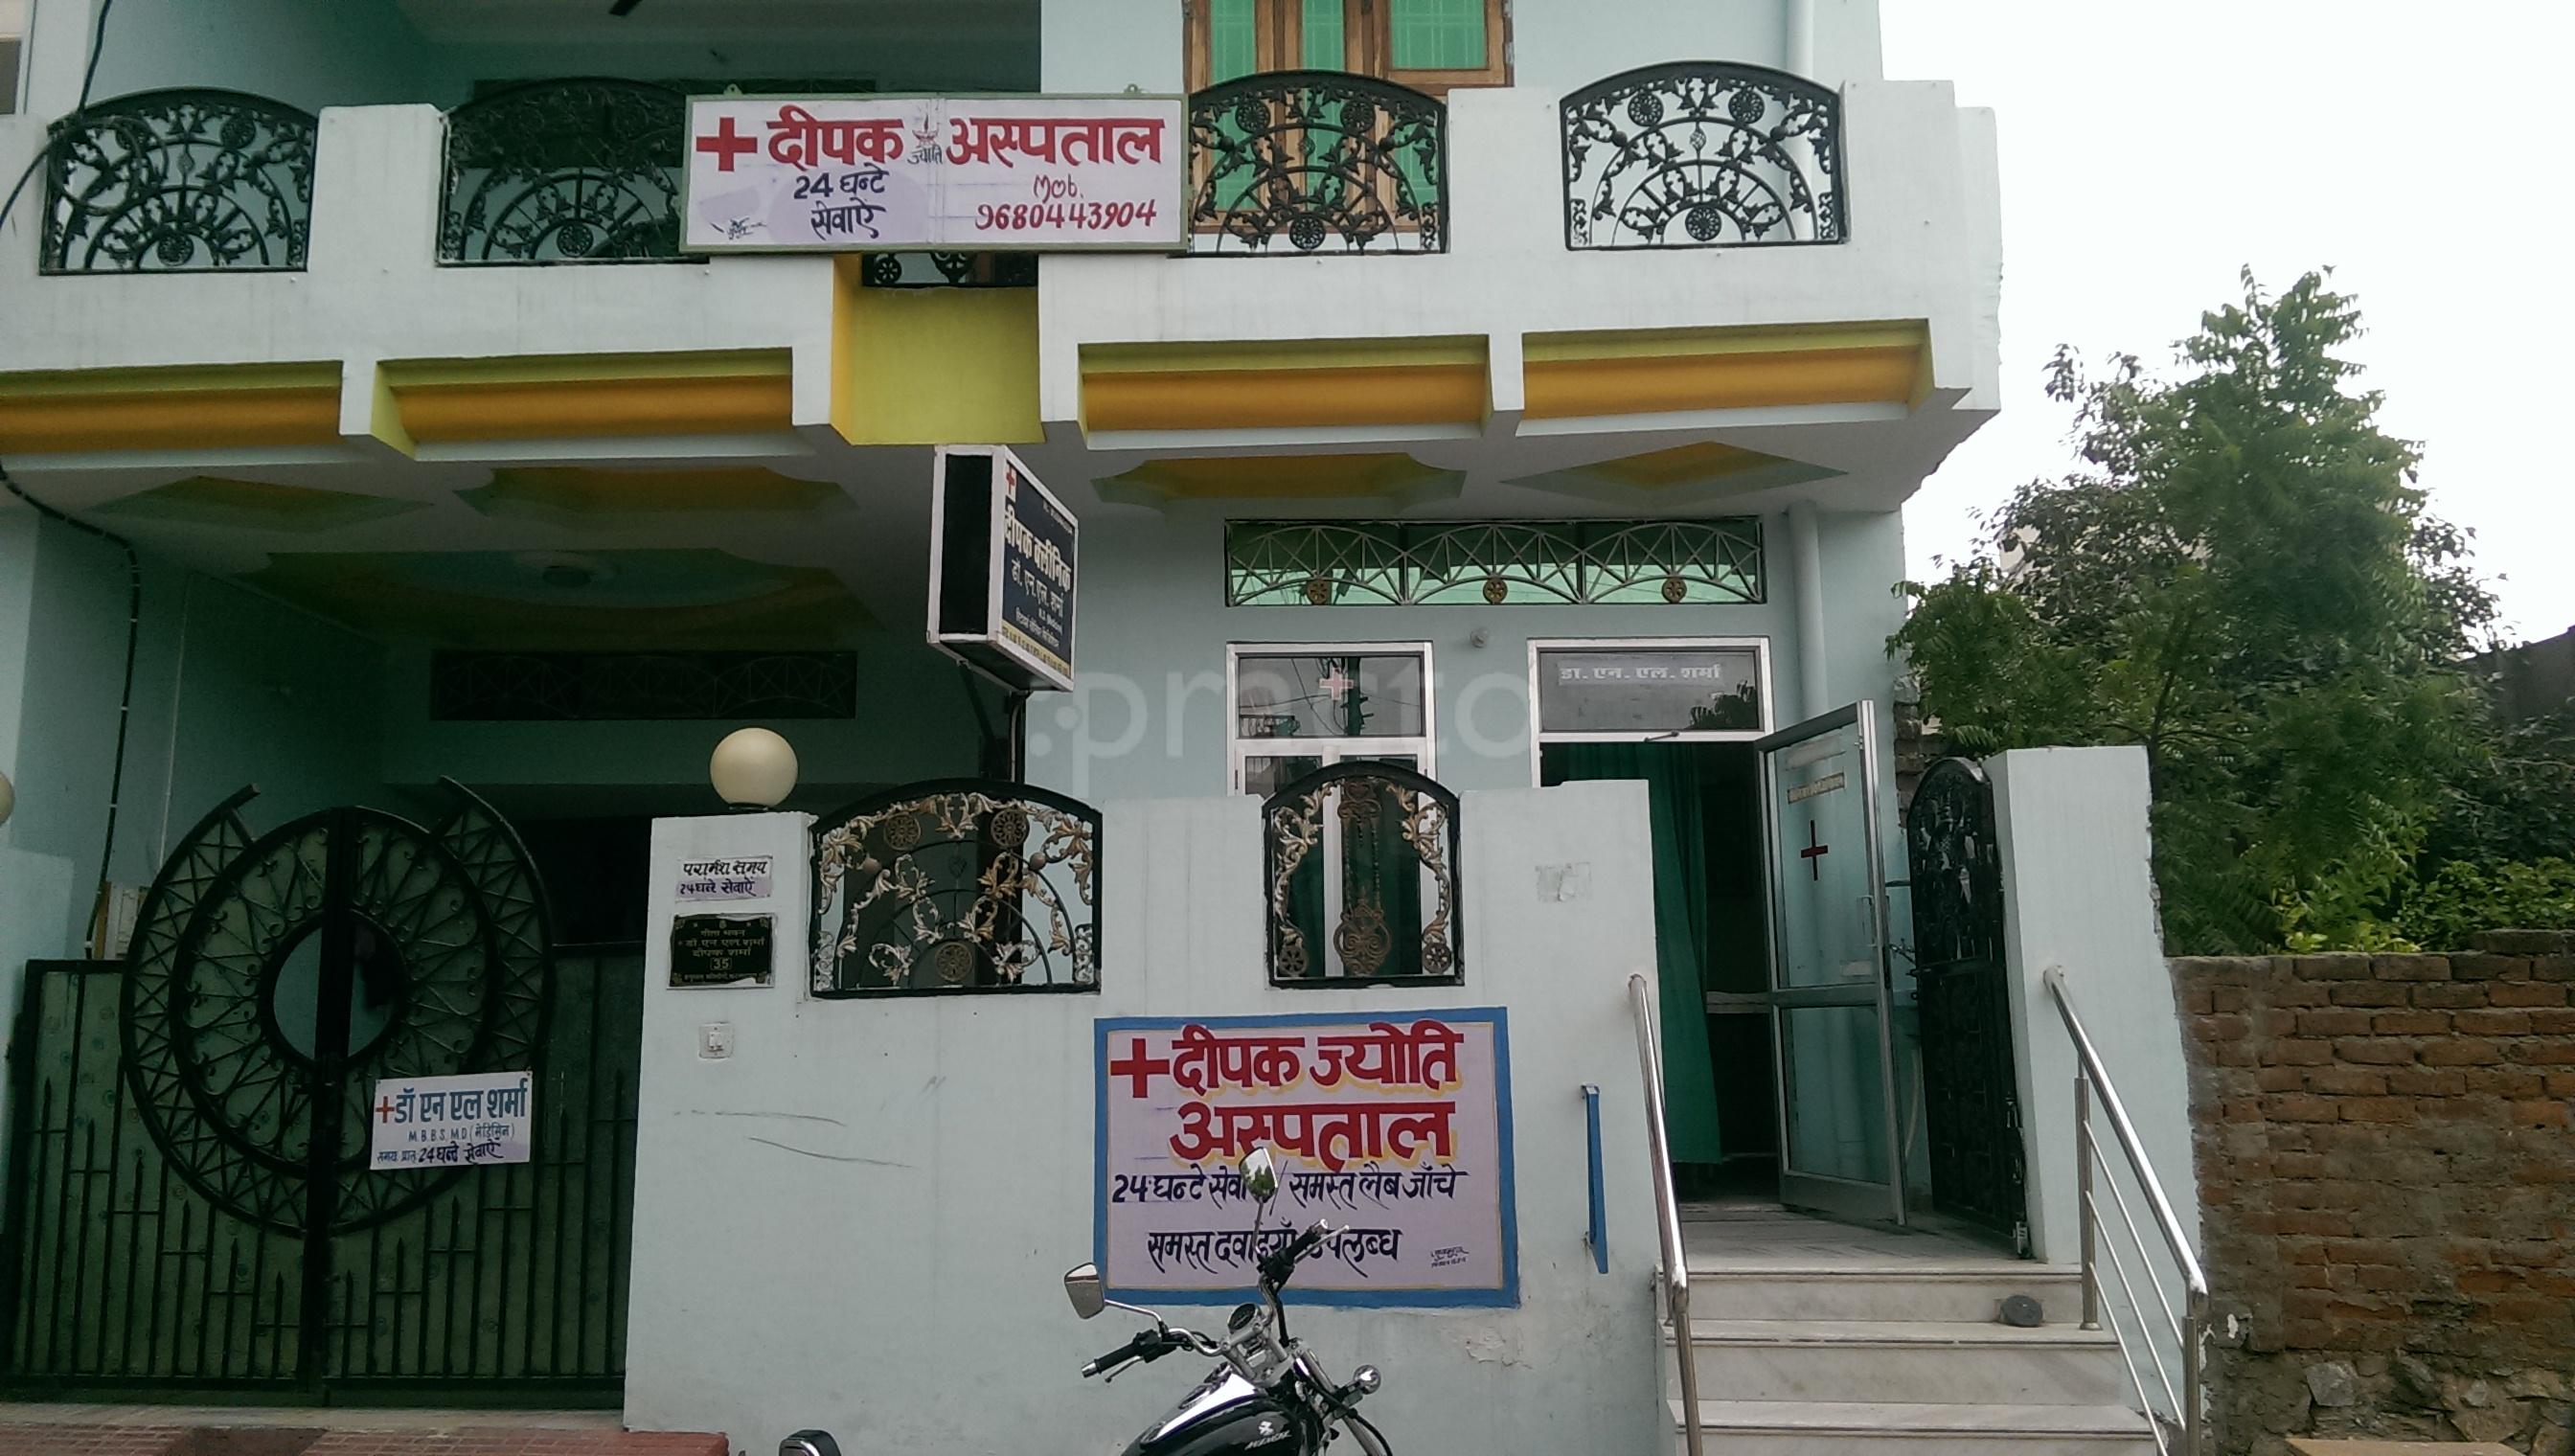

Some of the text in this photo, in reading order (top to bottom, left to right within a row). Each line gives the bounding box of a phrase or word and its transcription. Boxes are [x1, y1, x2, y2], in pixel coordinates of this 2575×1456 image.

[766, 104, 903, 170] दीपक
[946, 116, 1166, 168] अस्पताल
[793, 172, 833, 199] 24
[975, 199, 1157, 230] 9680443904
[713, 959, 729, 968] 35
[1172, 1019, 1464, 1096] दीपक ज्योति
[395, 1078, 529, 1123] डॉ एन एल शर्मा
[1170, 1101, 1456, 1172] अस्पताल
[1112, 1174, 1149, 1203] 24
[1289, 1172, 1358, 1210] समस्त
[1148, 1232, 1218, 1274] समस्त
